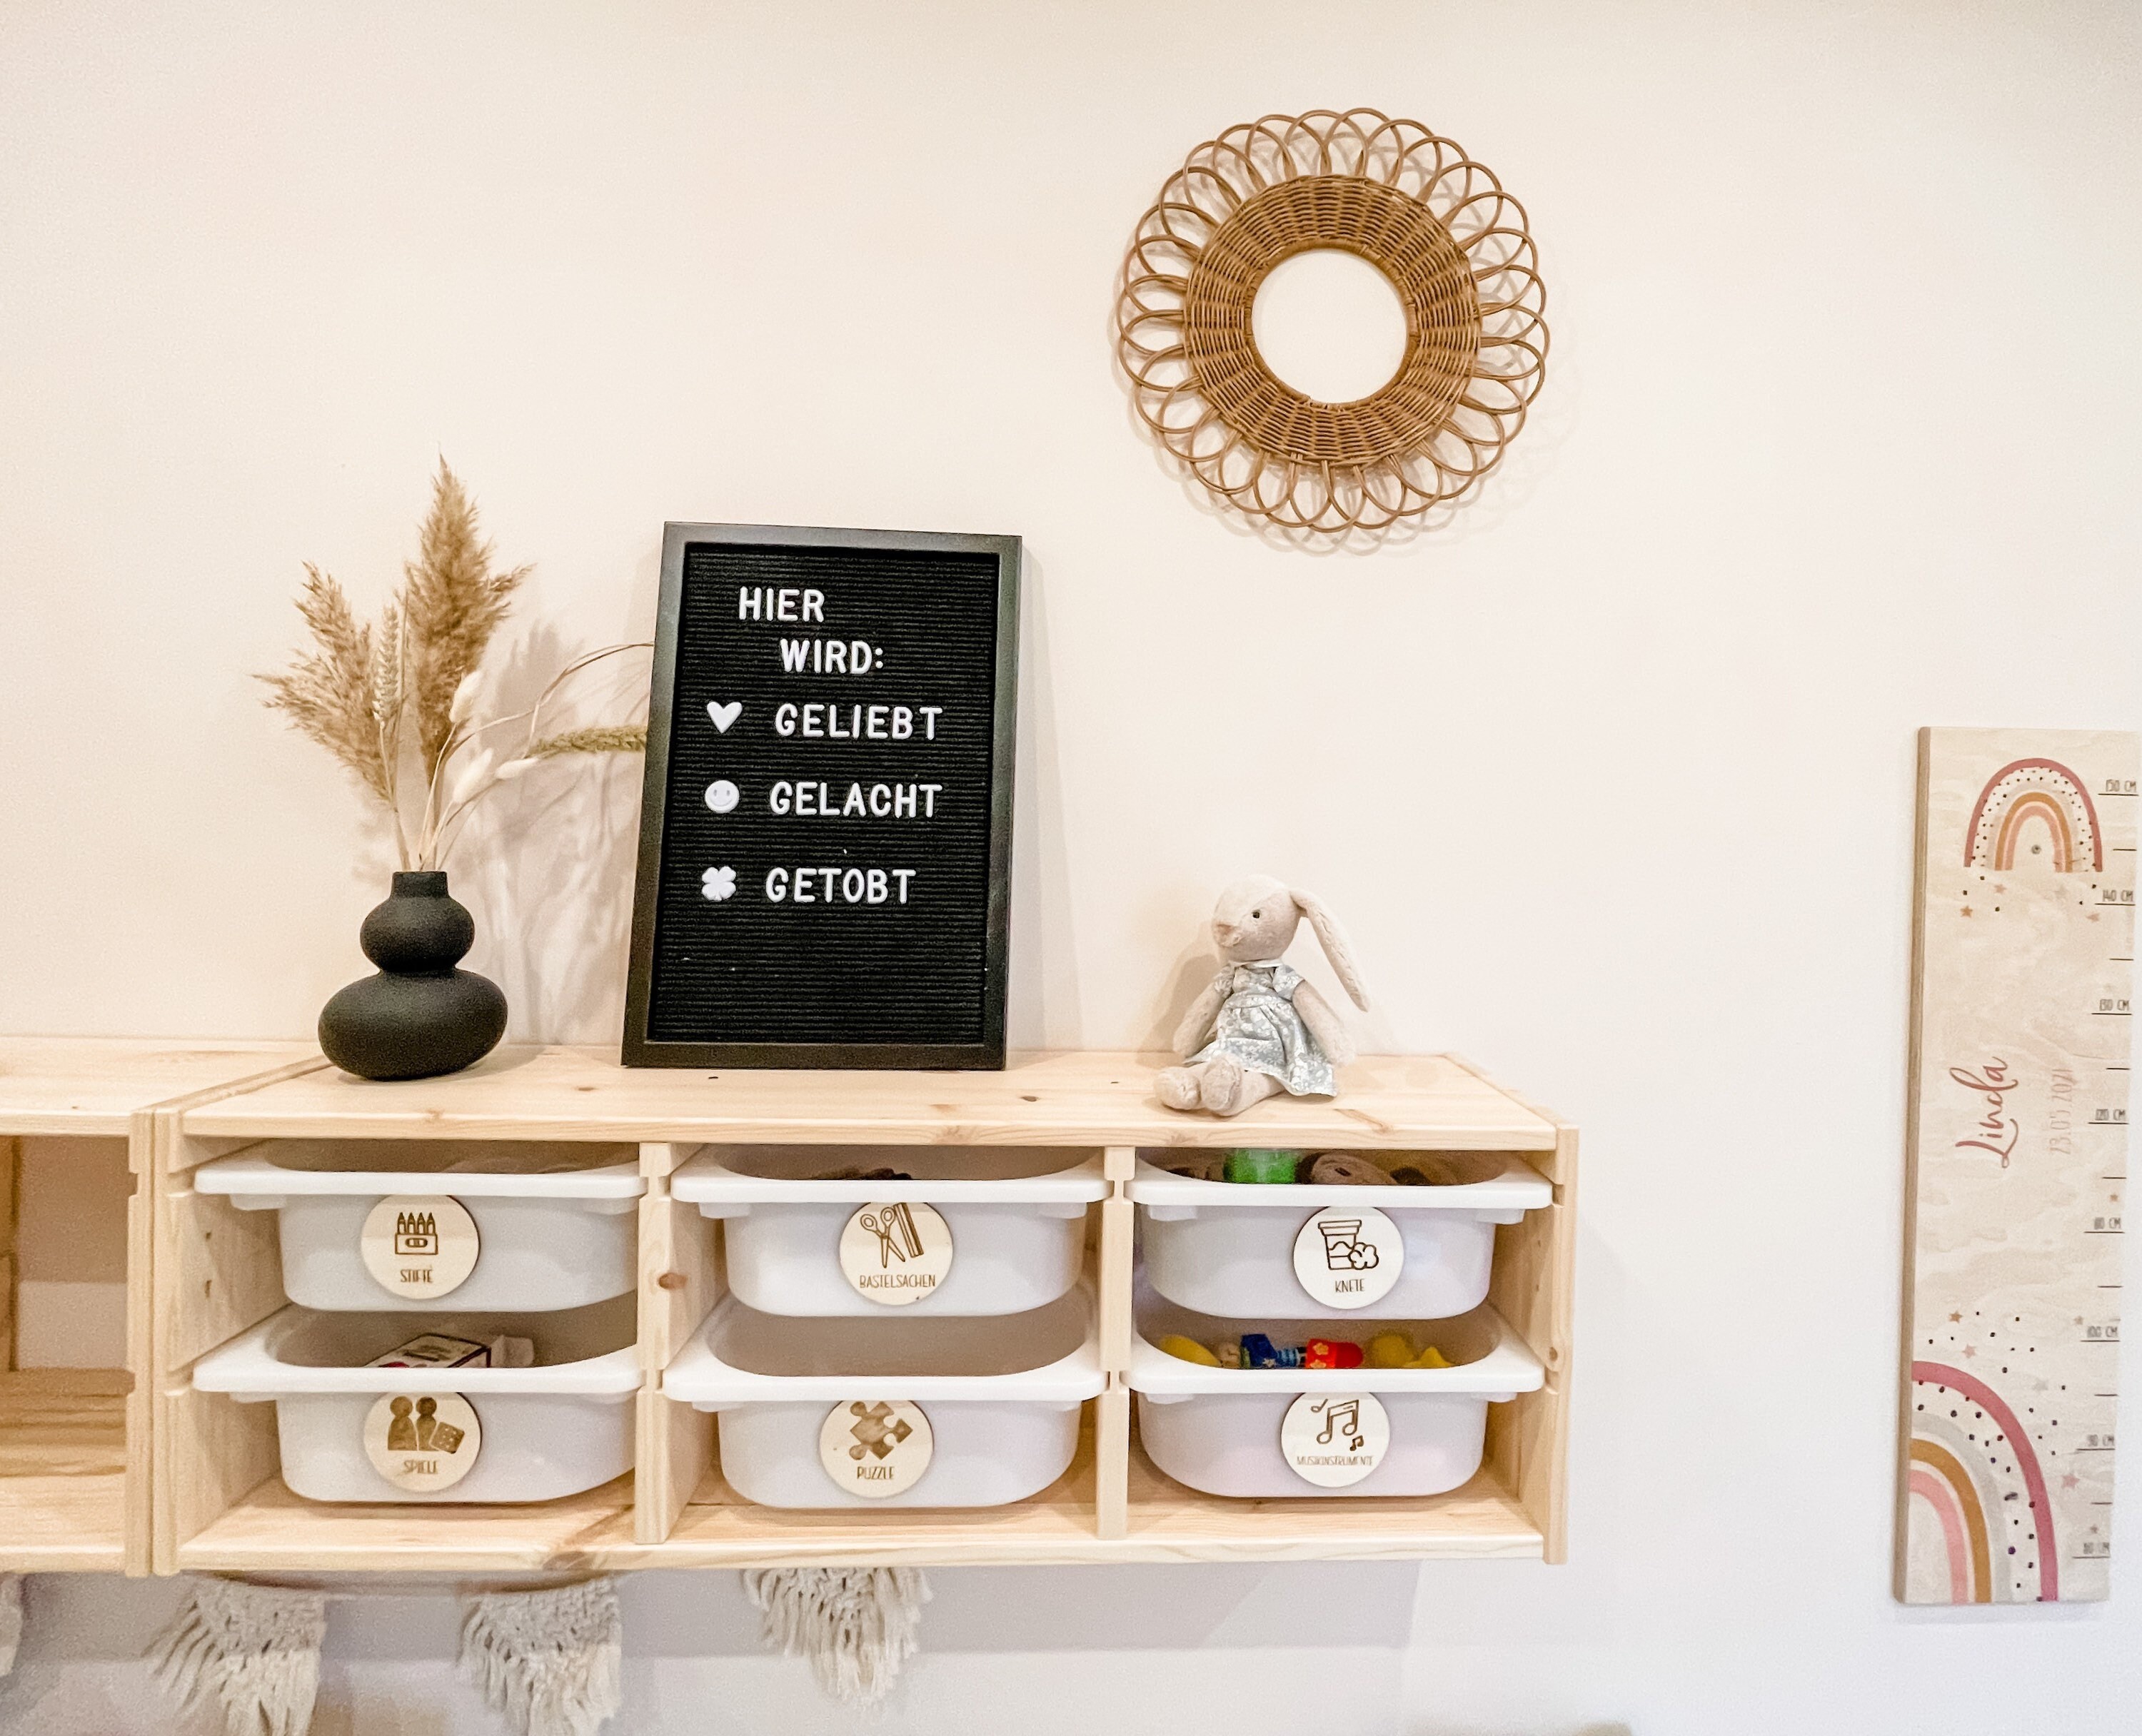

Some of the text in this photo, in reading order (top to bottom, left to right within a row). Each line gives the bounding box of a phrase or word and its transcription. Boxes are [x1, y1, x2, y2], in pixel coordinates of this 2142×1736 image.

[738, 587, 825, 622] HIER
[780, 638, 884, 675] WIRD:
[774, 703, 942, 740] GELIEBT
[770, 782, 942, 817] GELACHT
[765, 867, 916, 904] GETOBT
[2121, 889, 2133, 902] CM
[2117, 999, 2130, 1011] CM
[1949, 1056, 2018, 1169] Linda
[2113, 1109, 2126, 1121] CM
[400, 1268, 434, 1283] STIFTE
[859, 1274, 935, 1288] BASTELSACHEN
[1335, 1278, 1365, 1293] KNETE
[857, 1466, 895, 1480] PUZZLE
